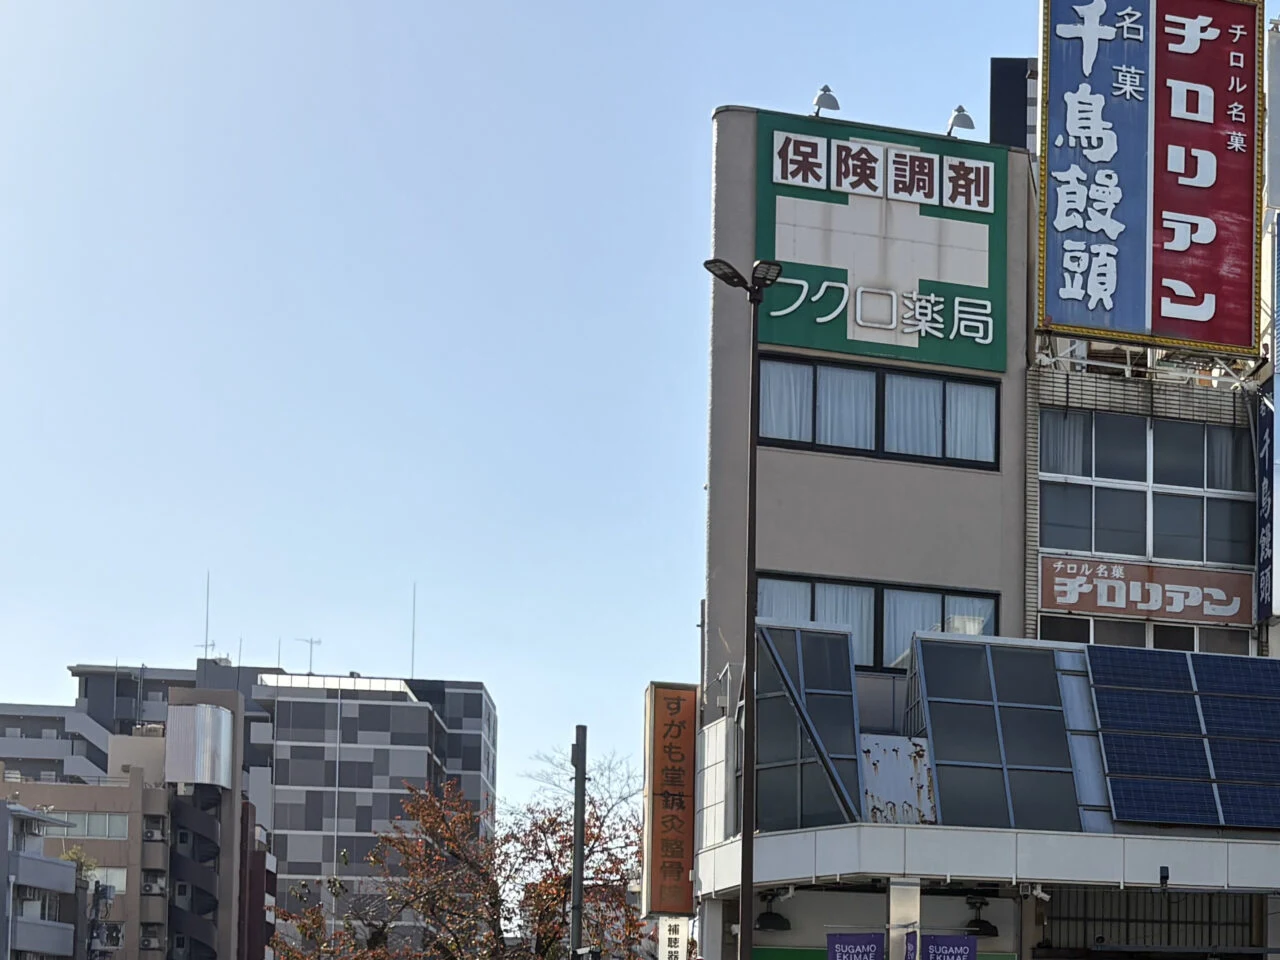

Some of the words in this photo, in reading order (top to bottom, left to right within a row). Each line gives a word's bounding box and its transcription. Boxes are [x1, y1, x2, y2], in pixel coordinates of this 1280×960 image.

[1112, 6, 1146, 102] 名菓
[1226, 24, 1248, 154] チロル名菓
[777, 135, 991, 209] 保険調剤
[1160, 13, 1221, 323] チロリアン
[769, 276, 994, 346] フクロ薬局
[1052, 560, 1125, 579] チロル名菓
[1053, 576, 1241, 617] チロリアン
[834, 943, 877, 954] SUGAMO
[928, 944, 970, 955] SUGAMO
